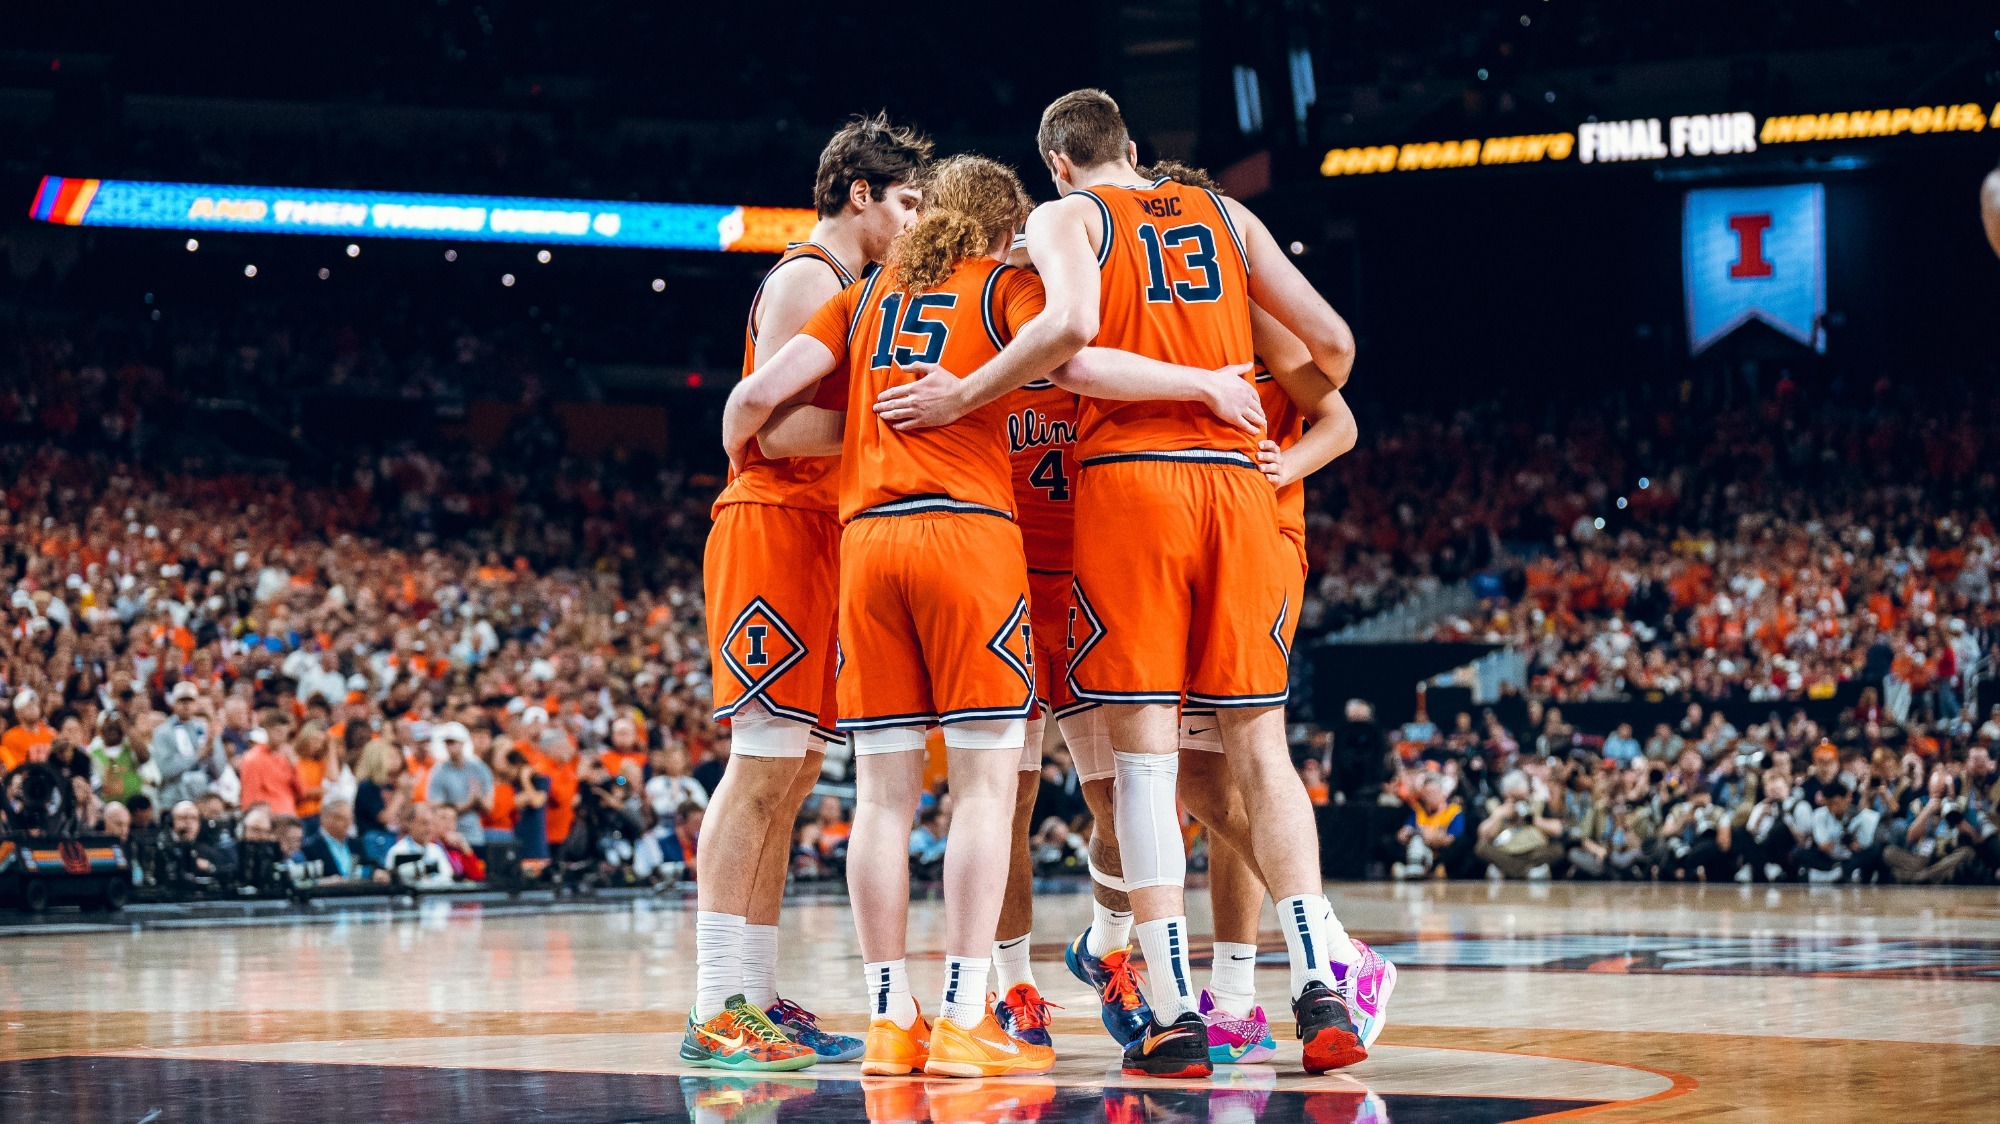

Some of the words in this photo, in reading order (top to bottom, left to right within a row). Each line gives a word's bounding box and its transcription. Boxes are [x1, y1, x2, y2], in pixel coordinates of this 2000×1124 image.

[1480, 132, 1575, 165] MEN'S
[1578, 118, 1668, 164] FINAL
[1670, 111, 1757, 158] FOUR
[189, 197, 268, 221] AND
[273, 199, 368, 227] THEN
[372, 203, 486, 232] THERE
[490, 208, 591, 236] WERE
[1137, 222, 1223, 303] 13
[1729, 213, 1772, 279] I
[870, 291, 959, 370] 15
[1028, 448, 1070, 501] 4
[745, 624, 769, 667] I
